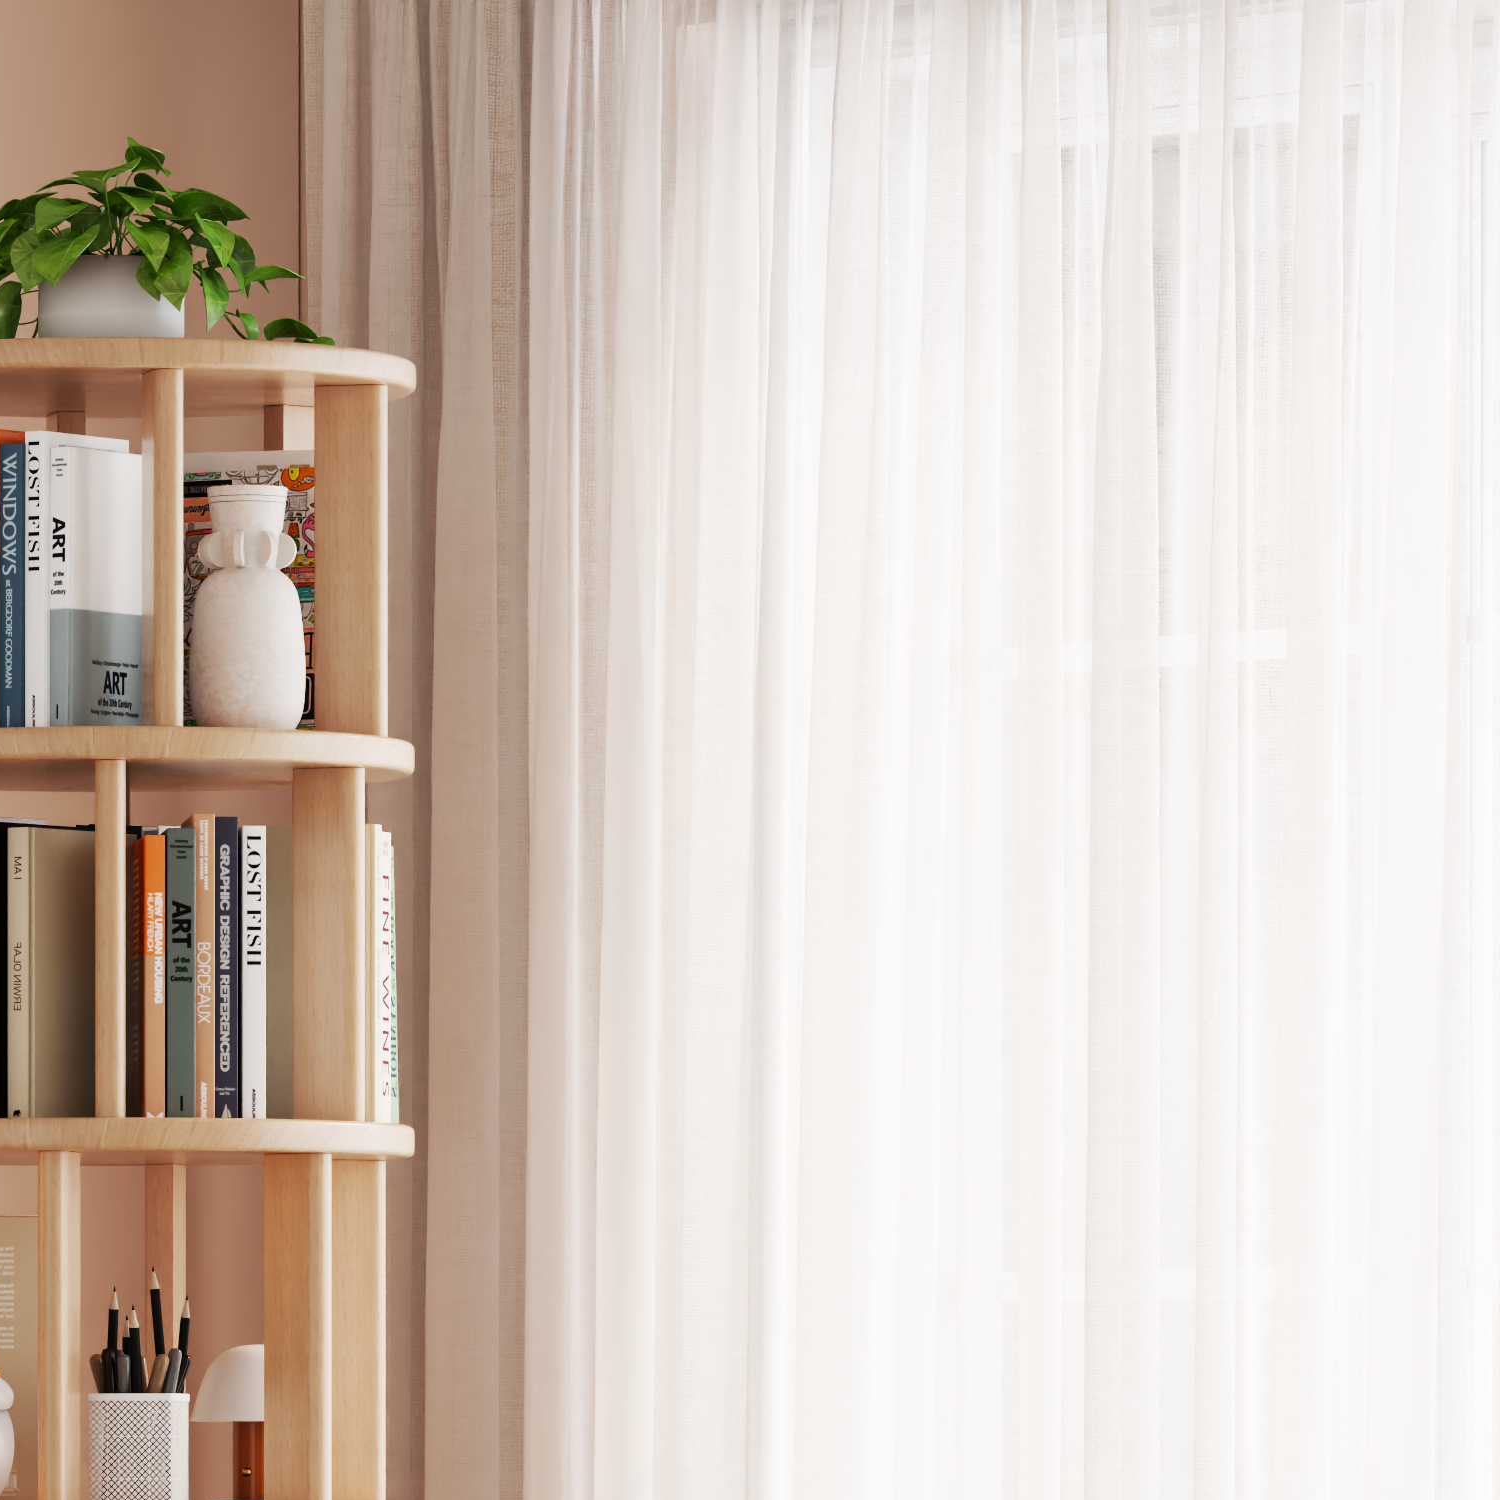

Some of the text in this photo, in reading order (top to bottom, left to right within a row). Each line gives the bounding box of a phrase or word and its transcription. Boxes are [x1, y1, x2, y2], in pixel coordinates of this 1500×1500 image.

[2, 452, 17, 575] WINDOWS
[28, 441, 40, 572] LOST FISH
[52, 517, 66, 562] ART
[5, 588, 13, 637] BERGDORF
[5, 638, 13, 689] GOODMAN
[103, 670, 127, 695] ART
[172, 900, 192, 949] ART
[247, 836, 262, 965] LOST FISH
[154, 892, 163, 1004] NEW URBAN HOUSING
[181, 956, 190, 964] the
[220, 844, 230, 1073] GRAPHIC DESIGN REFERENCED
[170, 975, 193, 983] Century
[197, 942, 211, 1024] BORDEAUX
